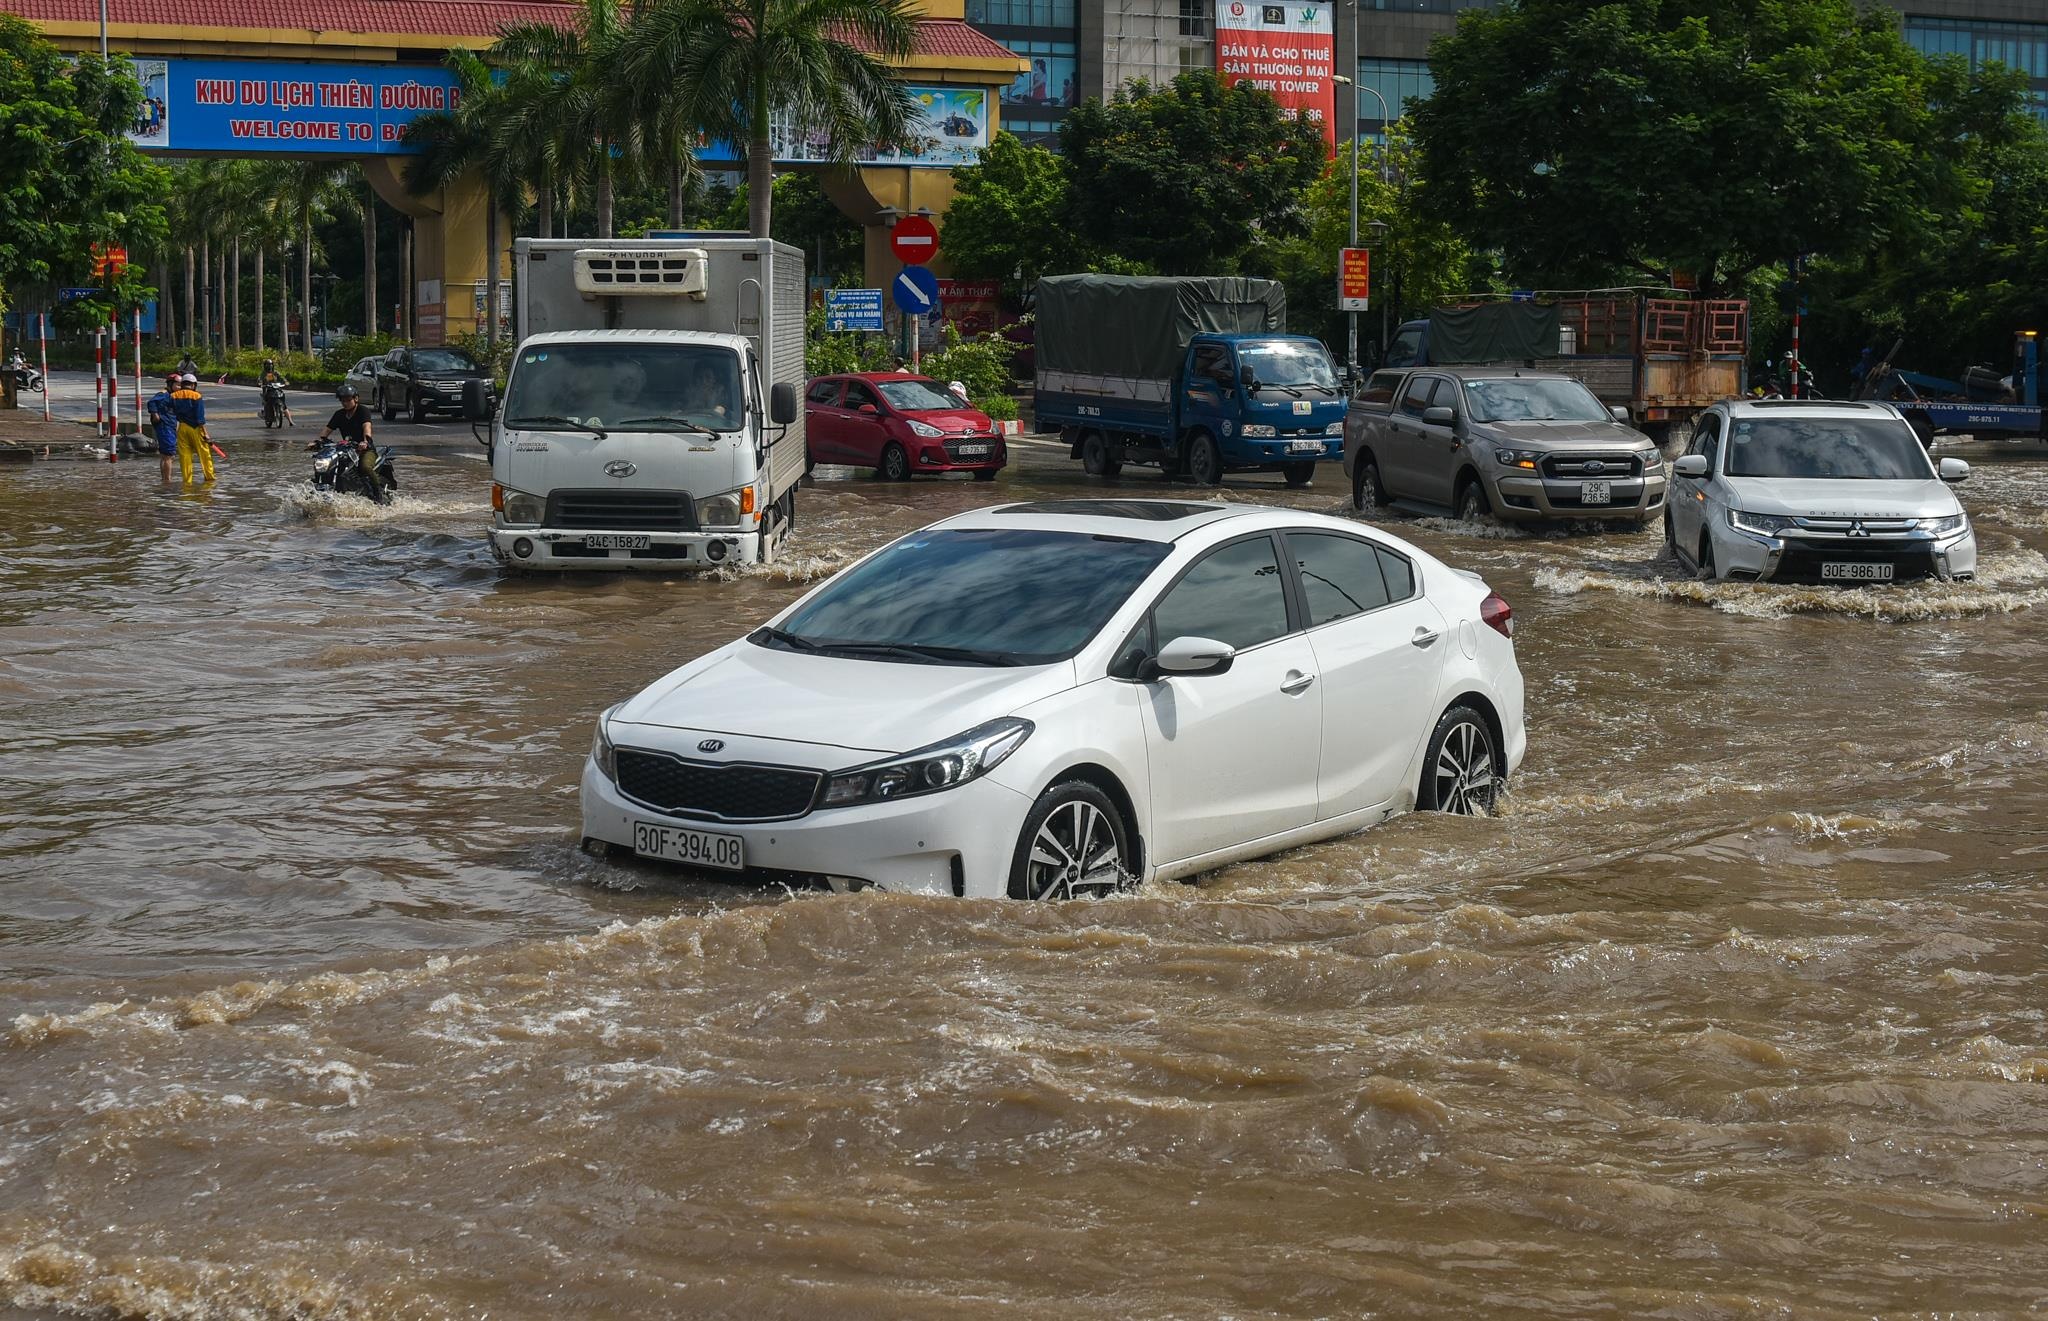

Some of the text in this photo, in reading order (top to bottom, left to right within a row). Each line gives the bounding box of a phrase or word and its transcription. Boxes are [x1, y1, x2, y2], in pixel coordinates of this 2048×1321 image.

[1221, 43, 1330, 61] BÁN VÀ CHO THUÊ
[1223, 60, 1328, 80] SÀN THƯƠNG MẠI
[196, 79, 235, 104] KHU
[240, 80, 266, 105] DU
[271, 81, 314, 111] LỊCH
[319, 79, 374, 109] THIÊN
[381, 80, 444, 110] ĐƯỜNG
[1280, 81, 1319, 93] TOWER
[230, 119, 341, 140] WELCOME
[345, 122, 373, 140] TO
[1589, 484, 1604, 492] 29C
[588, 536, 649, 549] 34C-158.27
[1823, 564, 1892, 579] 30E-986.10
[699, 740, 721, 751] KIA
[637, 826, 741, 867] 30F-394.08
